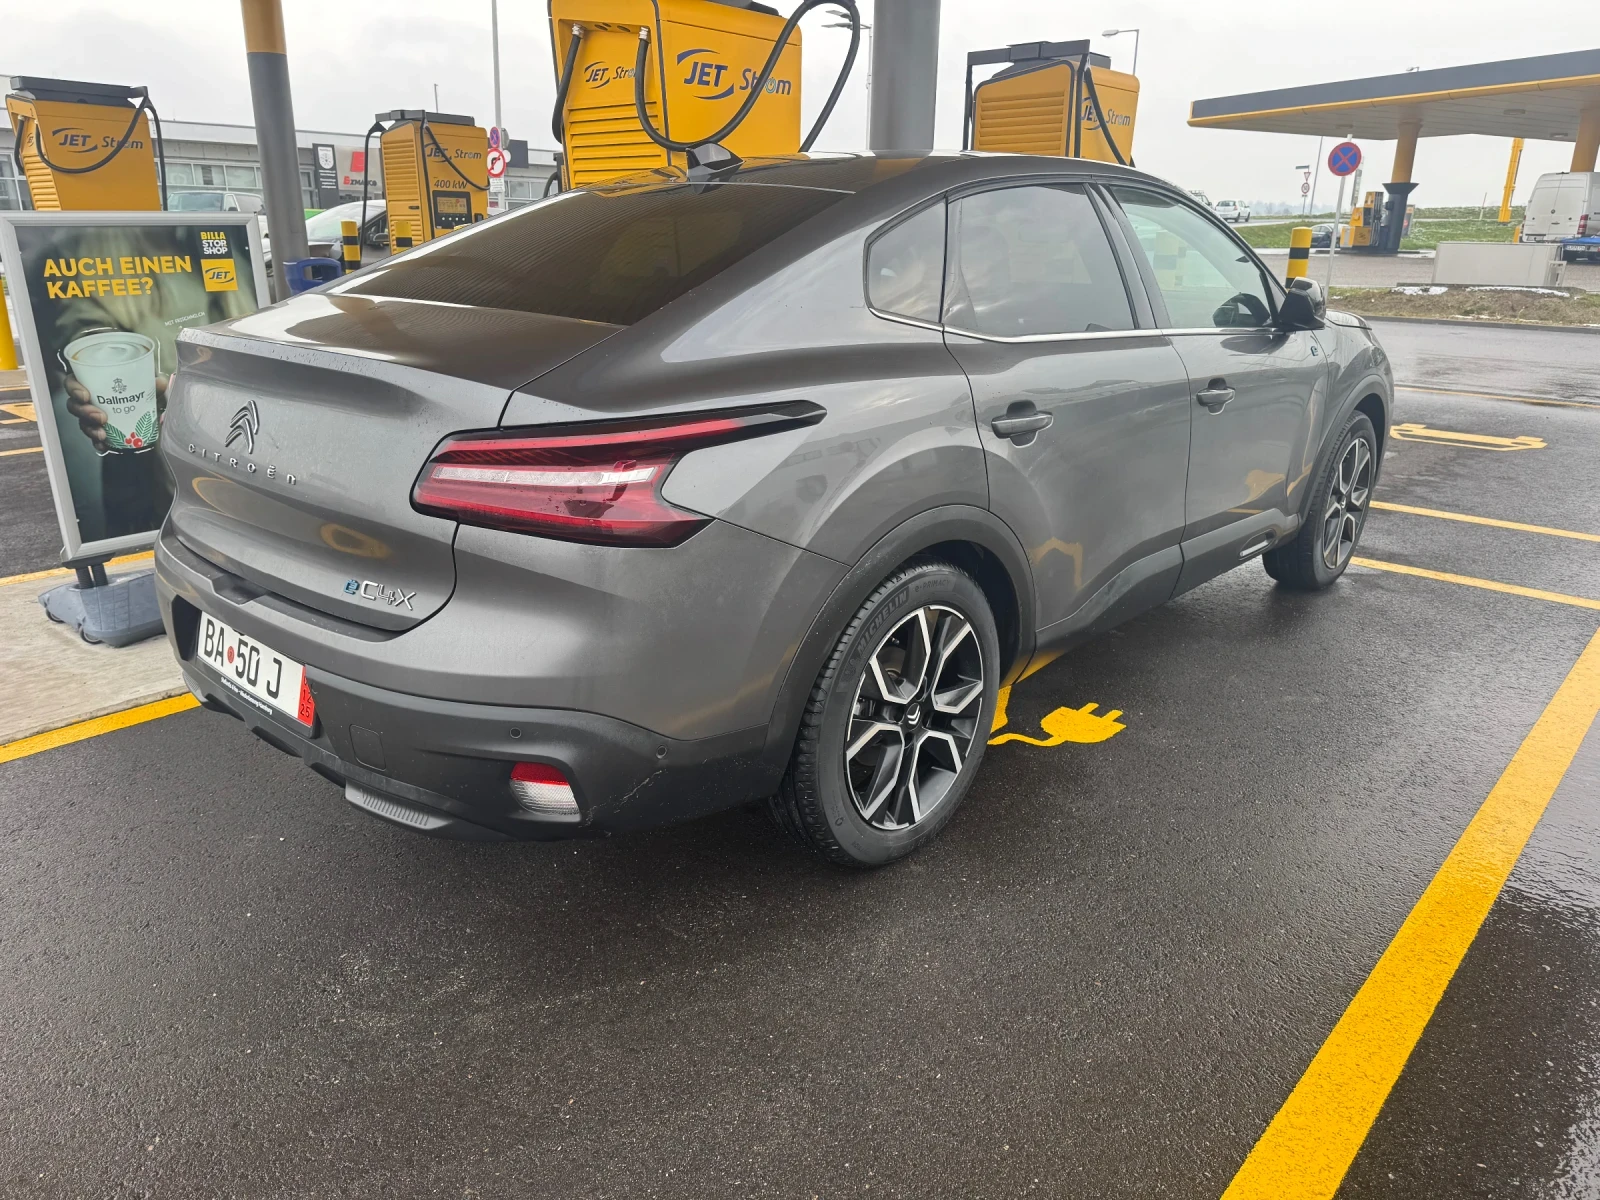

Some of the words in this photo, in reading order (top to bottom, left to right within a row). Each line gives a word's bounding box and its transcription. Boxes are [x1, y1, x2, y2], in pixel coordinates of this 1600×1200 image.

[585, 67, 609, 82] JET
[612, 65, 635, 80] Stro
[683, 61, 729, 88] JET
[739, 68, 792, 95] Stom
[1105, 108, 1131, 127] Strom
[59, 134, 92, 147] JET
[101, 135, 144, 149] Strm
[454, 149, 482, 160] Strom
[434, 179, 451, 189] 400
[452, 180, 468, 190] kW
[200, 231, 226, 240] BILLA
[202, 239, 228, 248] STOP
[203, 246, 228, 255] SHOP
[43, 256, 113, 278] AUCH
[119, 255, 192, 275] EINEN
[209, 271, 231, 280] JET
[47, 276, 154, 300] KAFFEE?
[96, 390, 145, 405] Dallmayr
[112, 406, 122, 414] to
[123, 405, 136, 415] go
[857, 590, 908, 654] MICHELIN
[203, 618, 226, 668] BA
[235, 637, 261, 688] 50
[266, 656, 283, 700] J
[299, 703, 311, 718] 25
